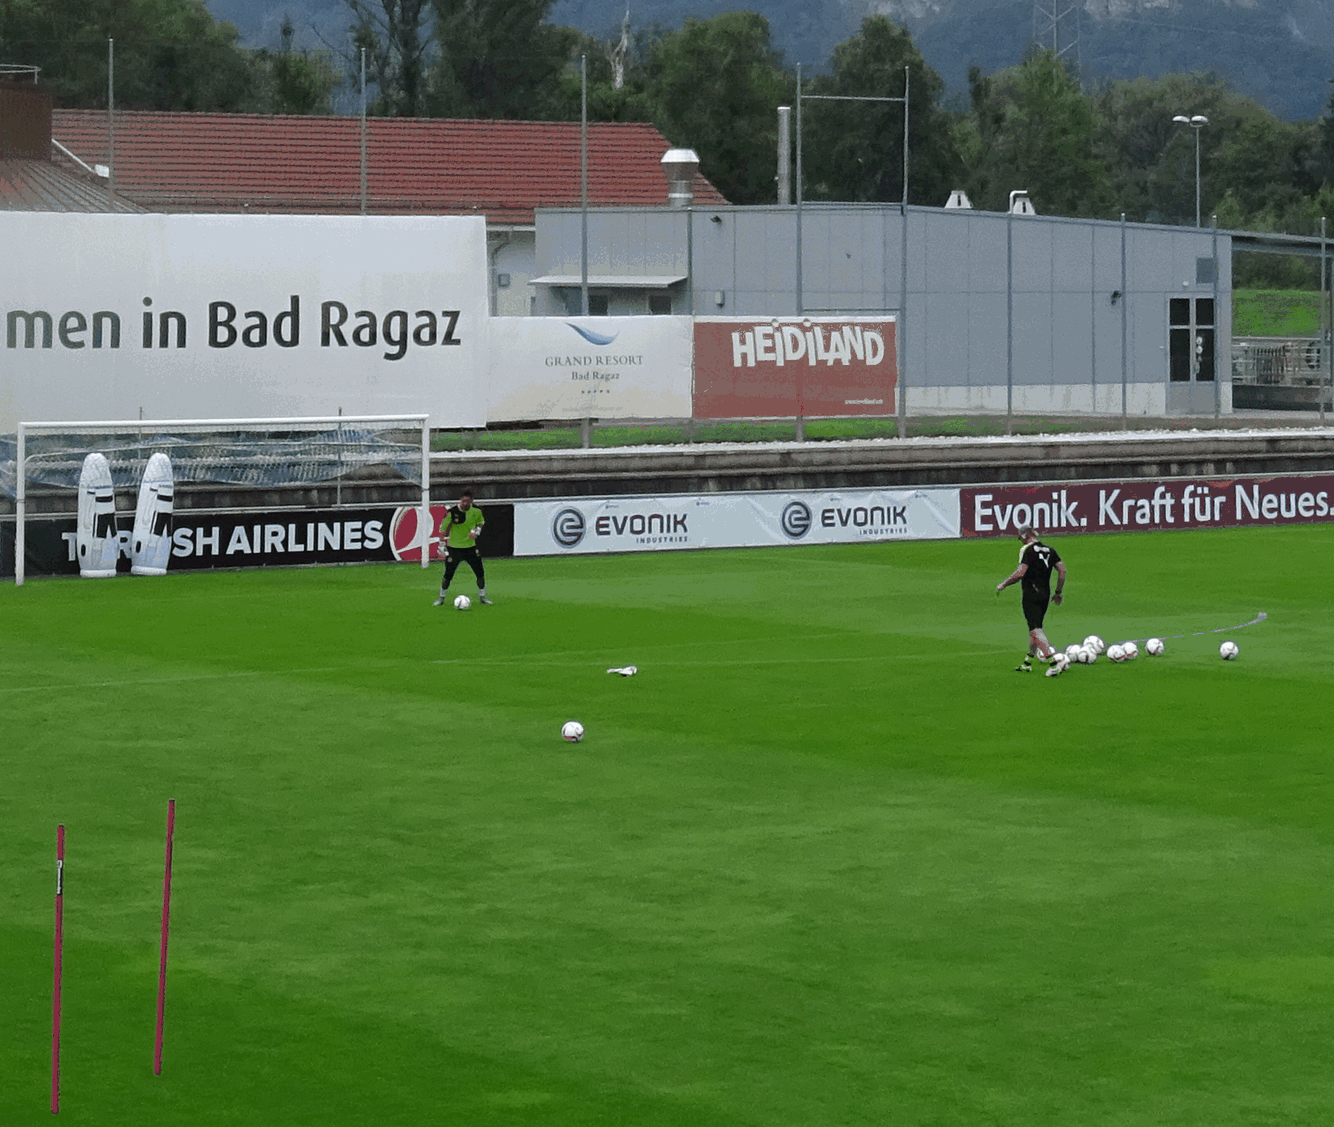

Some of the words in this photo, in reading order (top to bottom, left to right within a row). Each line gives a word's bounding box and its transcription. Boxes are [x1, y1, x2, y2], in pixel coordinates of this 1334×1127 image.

[142, 296, 187, 349] in
[208, 294, 300, 349] Bad
[320, 300, 462, 362] Ragaz
[544, 356, 592, 367] GRAND
[595, 355, 644, 366] RESORT
[571, 371, 591, 381] Bad
[592, 371, 620, 382] Ragaz
[820, 506, 908, 528] EVONIK
[974, 489, 1088, 532] Evonik.
[1098, 486, 1176, 526] Kraft
[1181, 485, 1226, 523] für
[595, 513, 688, 536] EVONIK
[859, 527, 908, 536] INDUSTRIES
[62, 525, 220, 562] TRSH
[225, 520, 384, 555] AIRLINES
[635, 536, 688, 544] INDUSTRIES
